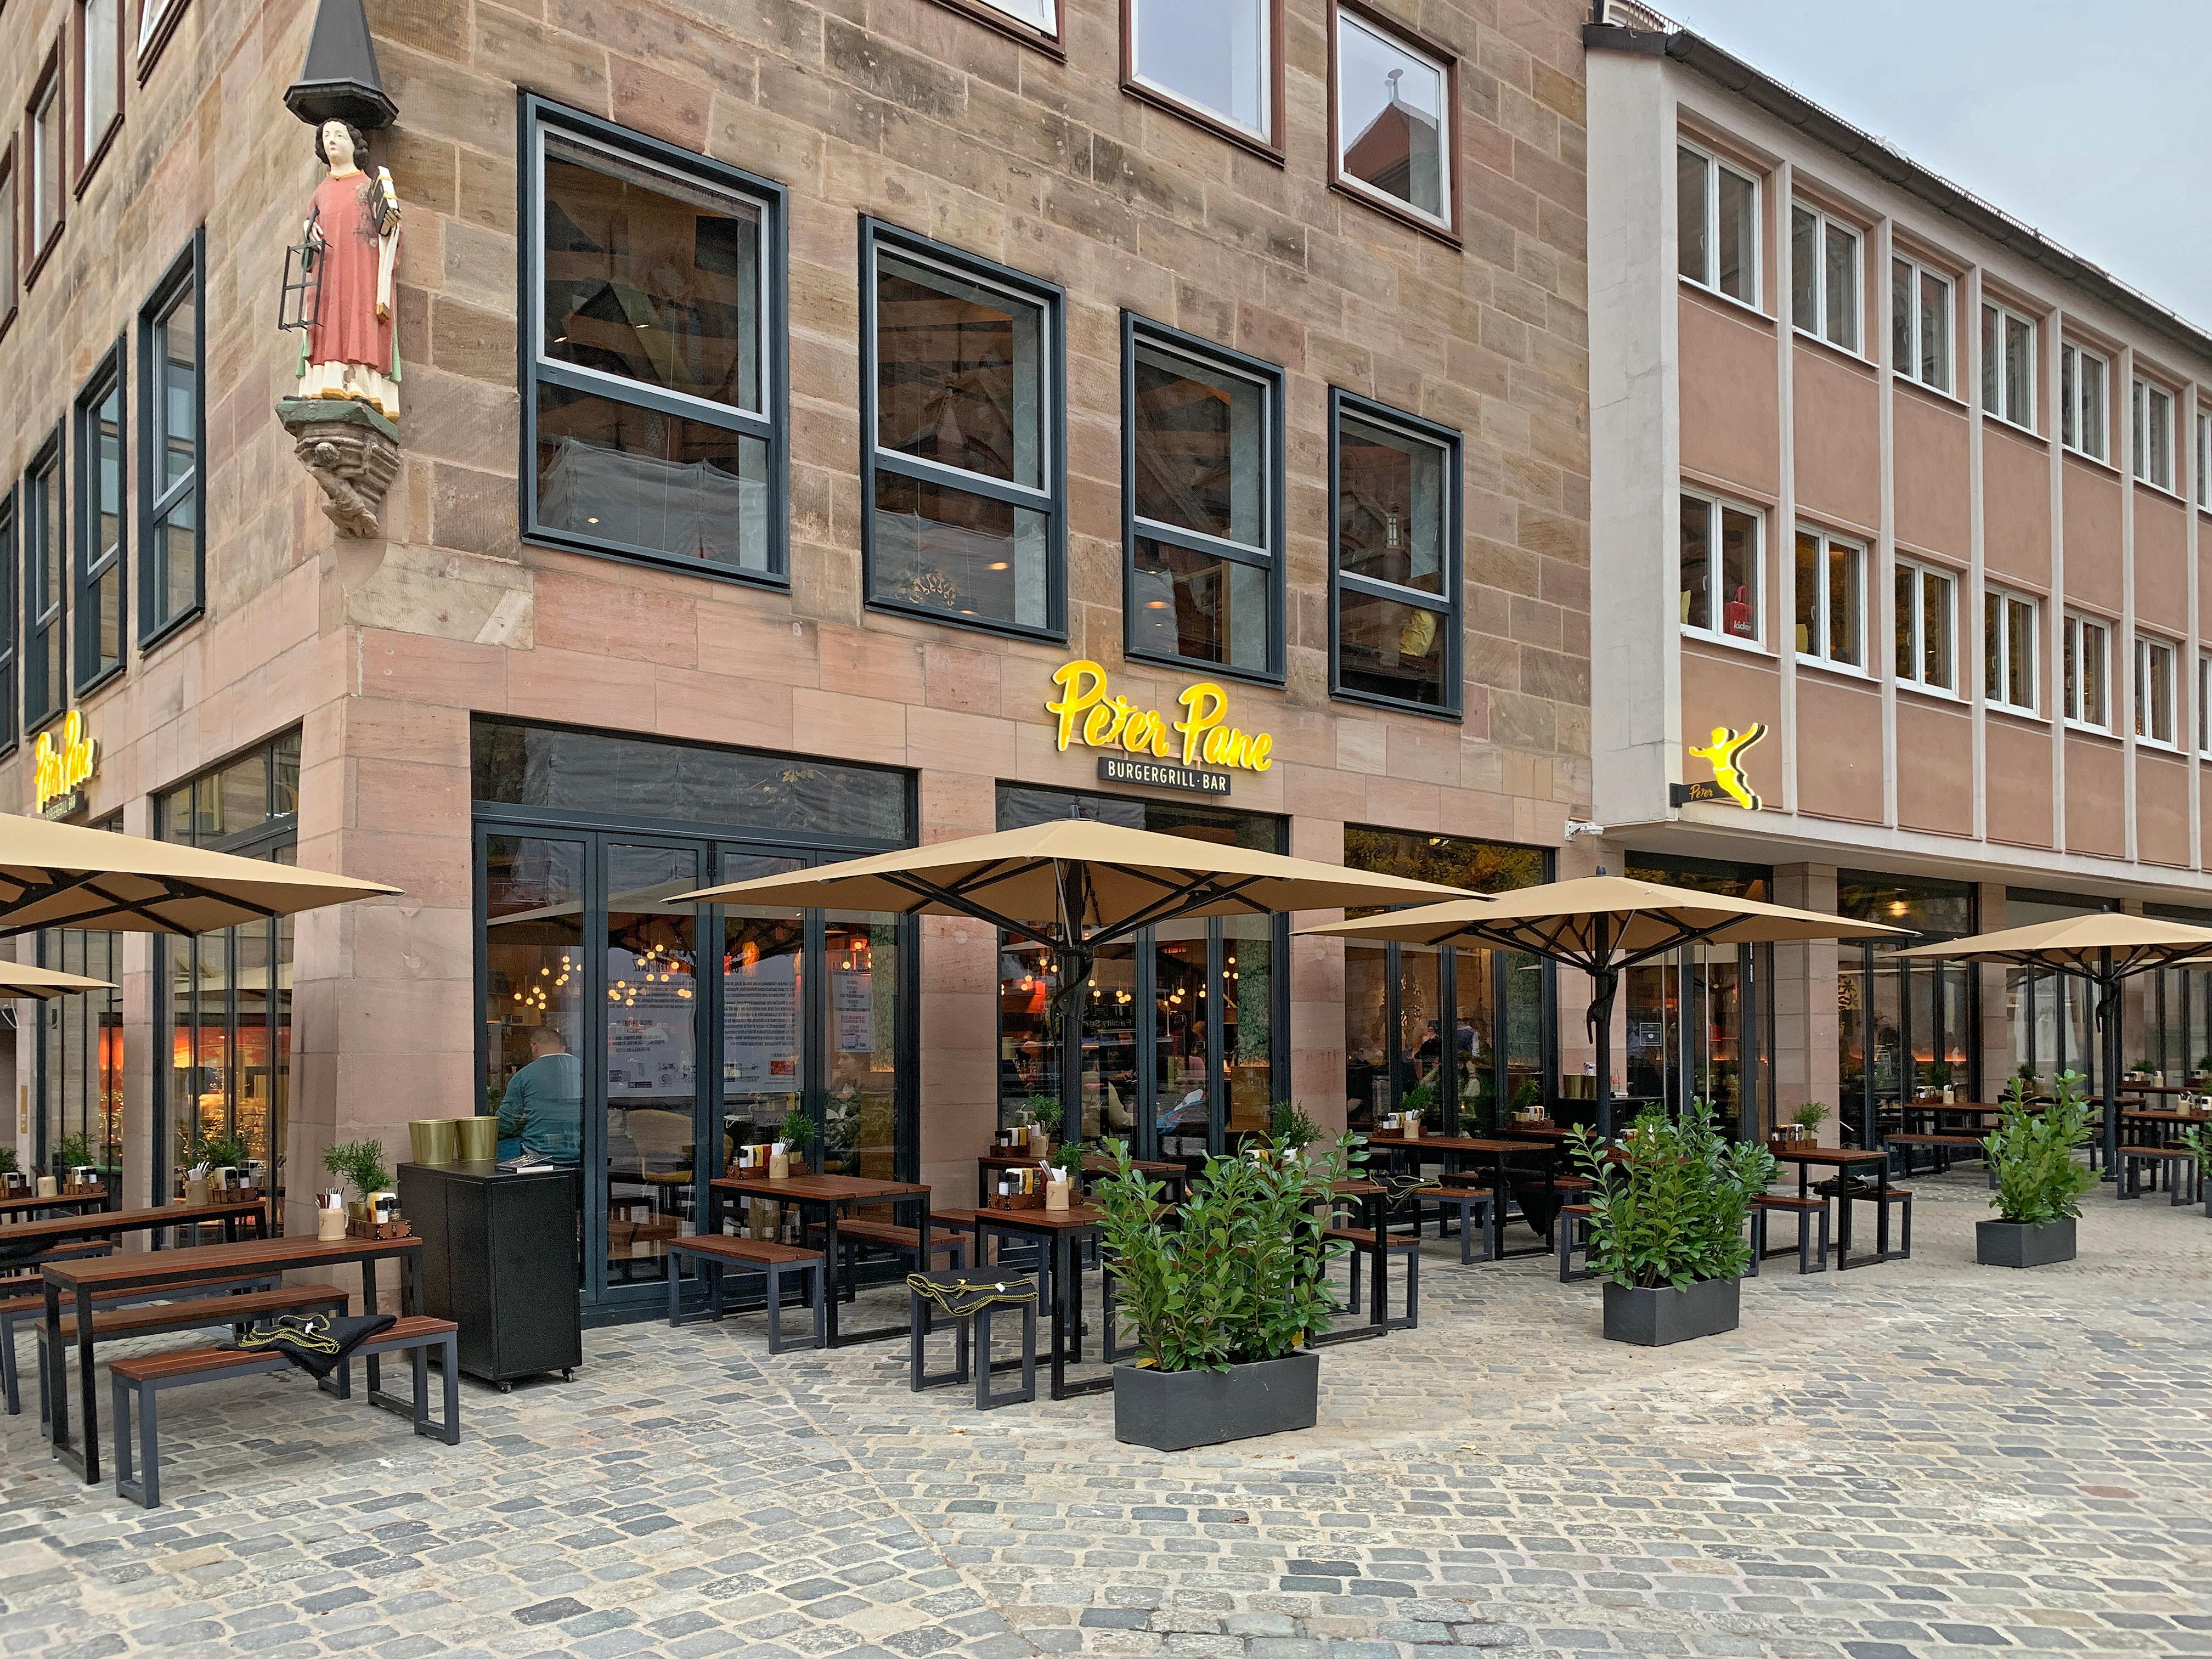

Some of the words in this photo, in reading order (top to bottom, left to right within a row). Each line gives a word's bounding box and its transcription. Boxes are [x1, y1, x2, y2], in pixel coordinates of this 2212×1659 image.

[1045, 659, 1170, 758] Peter
[1172, 682, 1272, 772] Pane
[1108, 760, 1196, 788] BURGERGRILL
[1202, 774, 1226, 792] BAR
[1689, 783, 1714, 801] Peter
